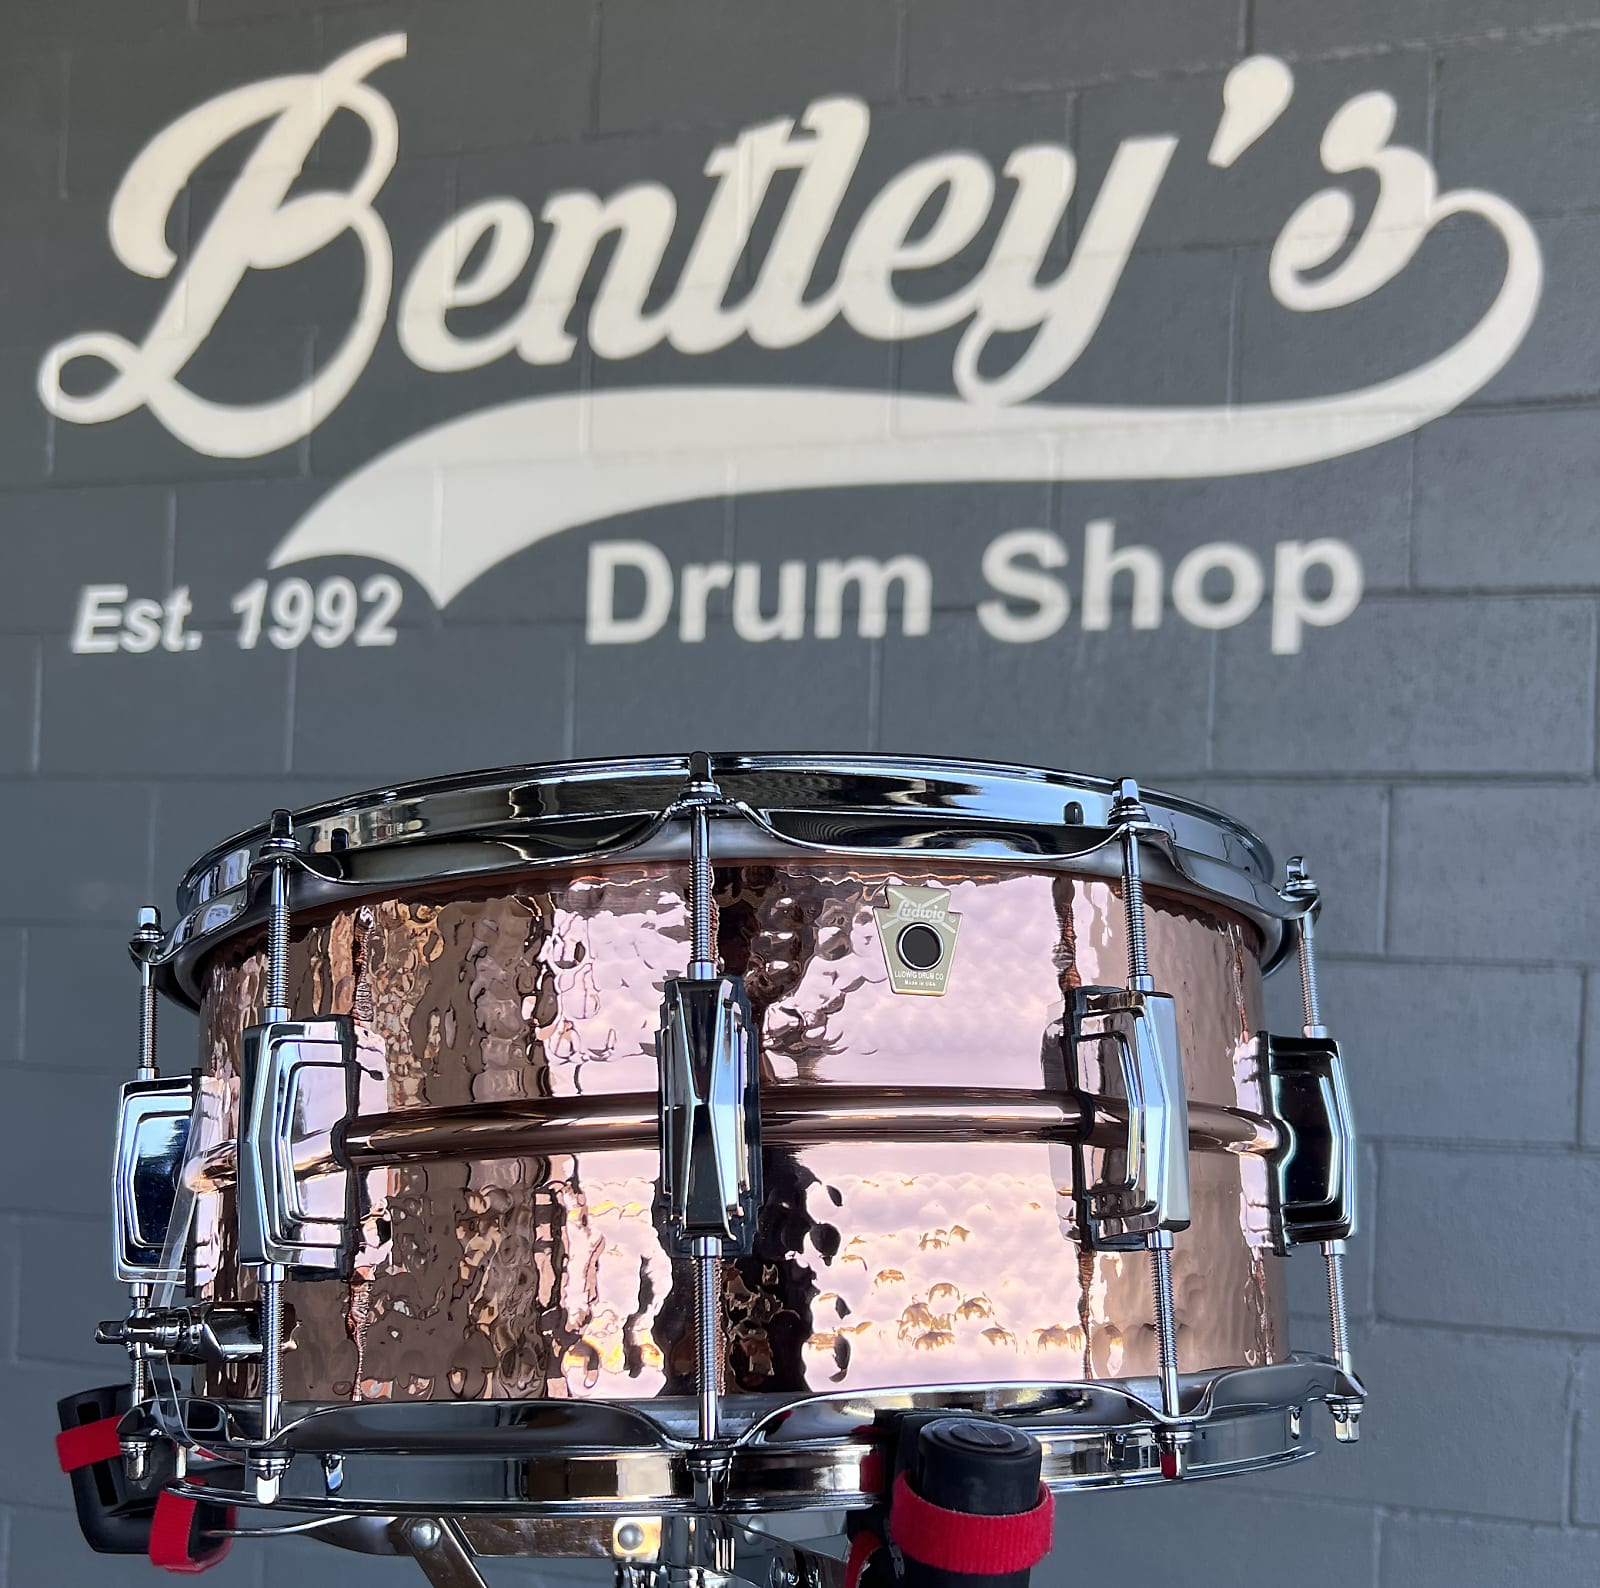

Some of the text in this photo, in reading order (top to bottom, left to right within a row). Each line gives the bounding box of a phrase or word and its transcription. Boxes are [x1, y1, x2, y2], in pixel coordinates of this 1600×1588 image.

[37, 33, 1544, 457] Bentley's
[72, 575, 404, 654] Est. 1992
[586, 521, 1364, 655] Drum Shop
[887, 898, 945, 924] Ludwig
